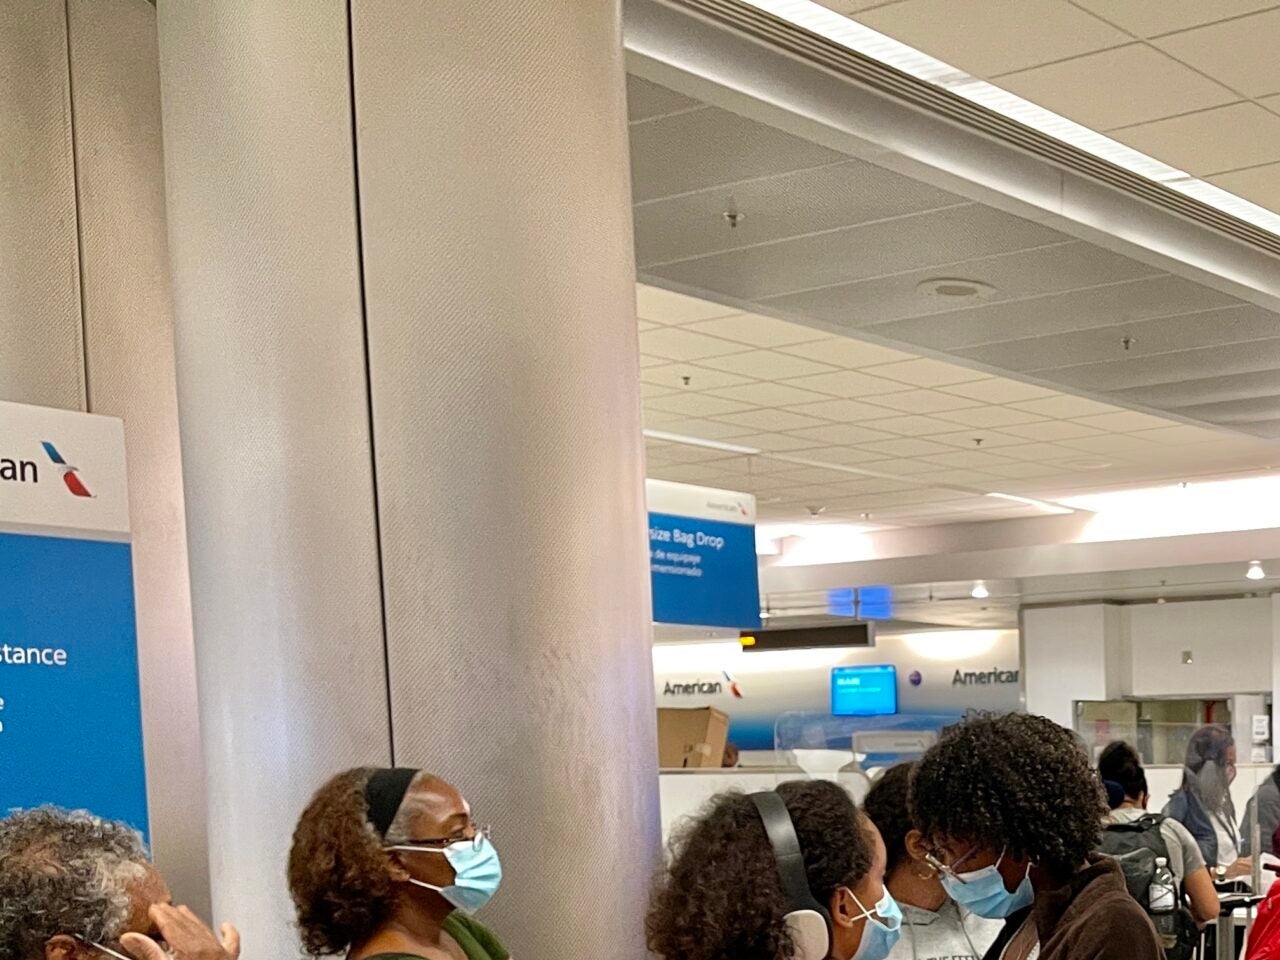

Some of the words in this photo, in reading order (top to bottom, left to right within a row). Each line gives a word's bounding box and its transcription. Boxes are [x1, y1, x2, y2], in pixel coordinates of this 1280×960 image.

[673, 528, 694, 548] Bag
[696, 531, 724, 550] Drop
[0, 643, 67, 665] tance
[663, 679, 722, 697] American
